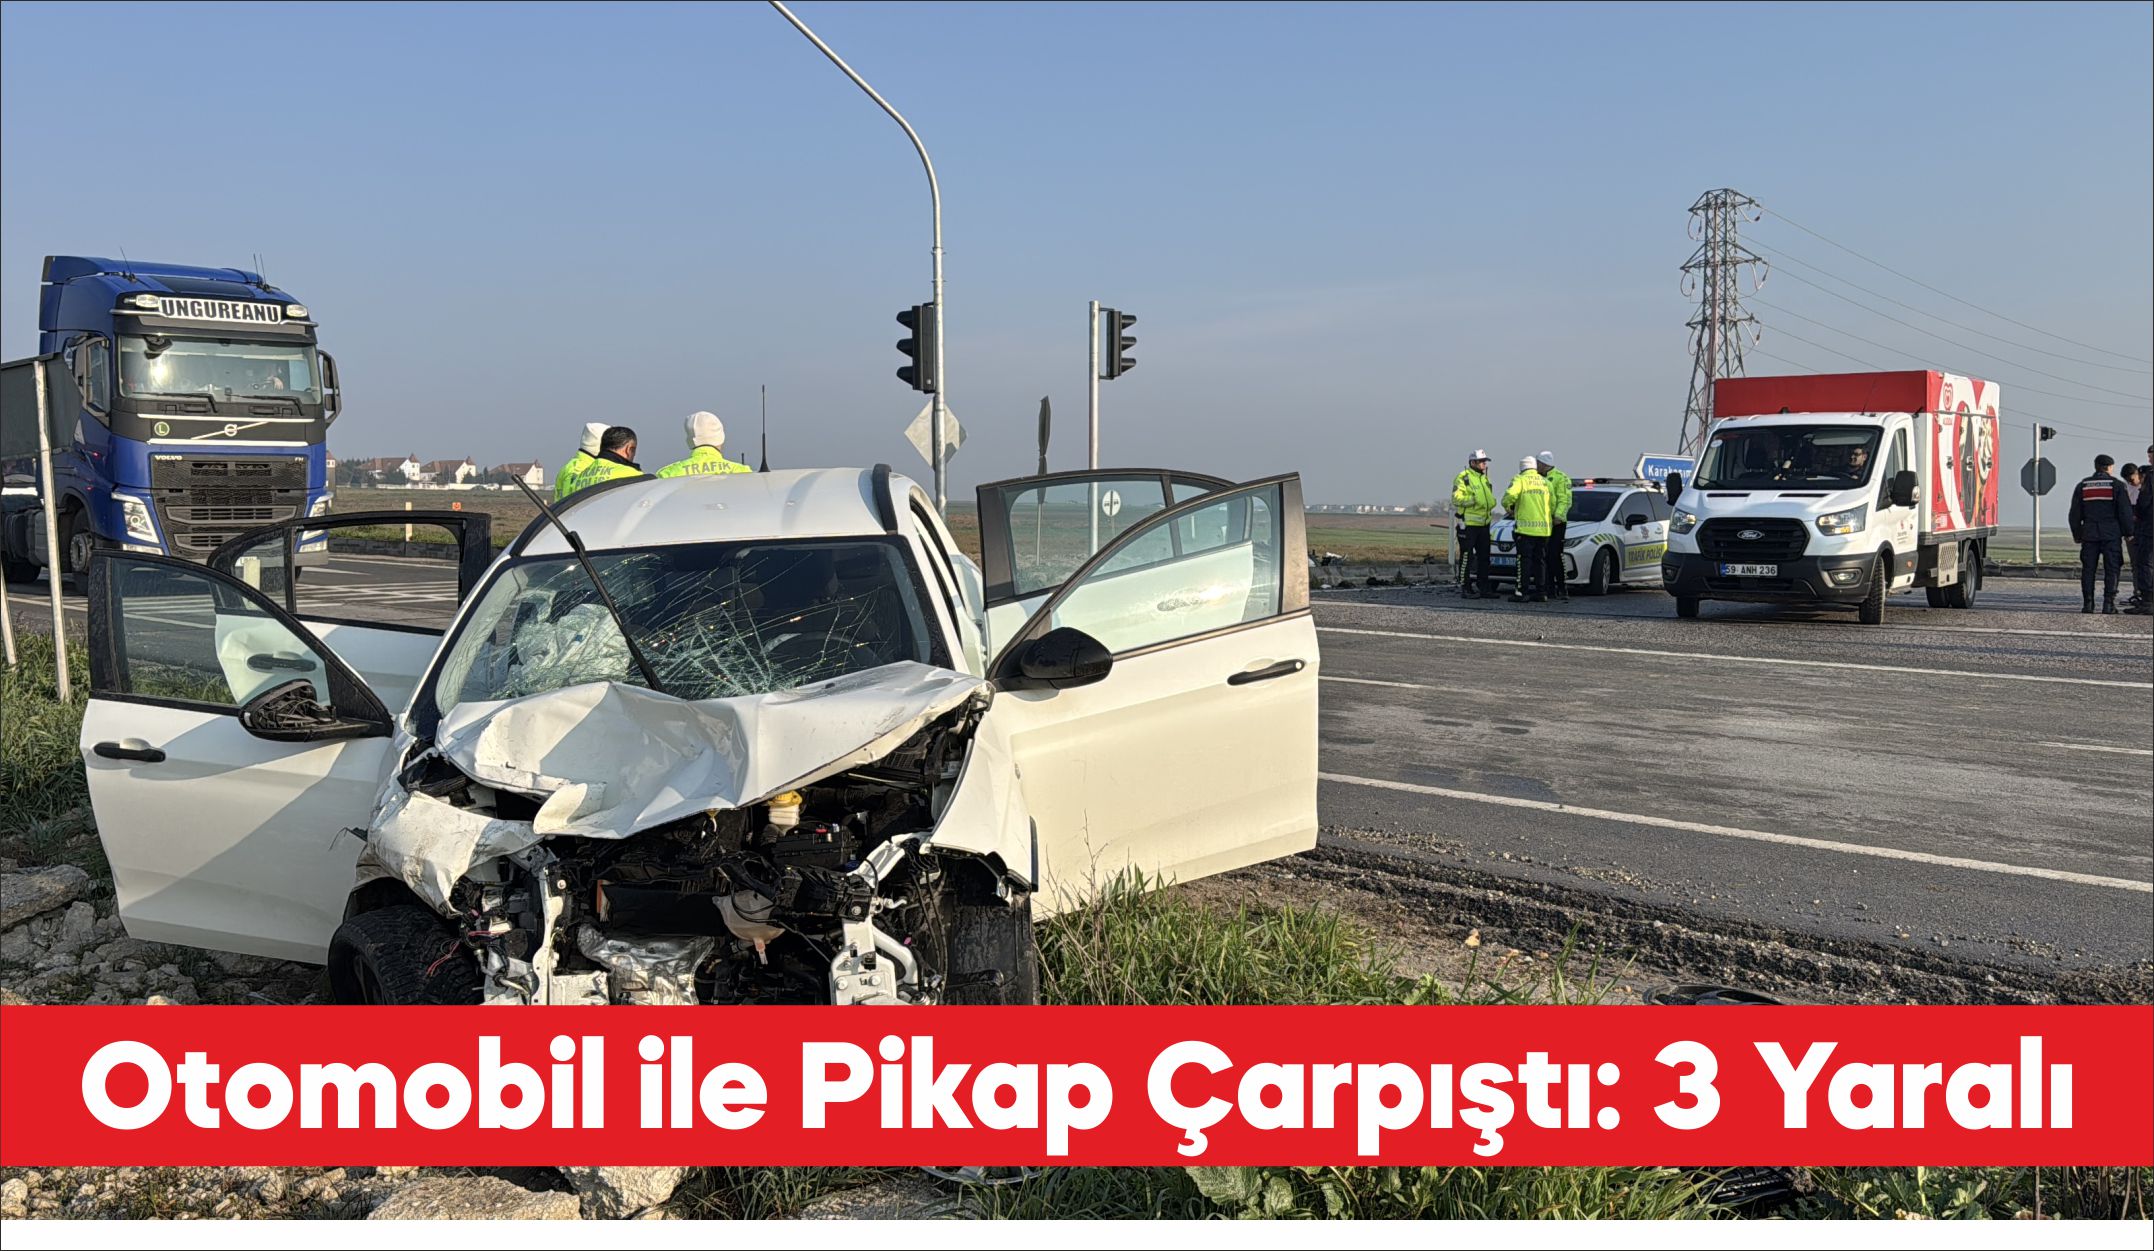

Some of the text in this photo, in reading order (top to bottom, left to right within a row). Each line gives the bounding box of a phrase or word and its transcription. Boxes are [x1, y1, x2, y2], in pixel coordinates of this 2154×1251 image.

[161, 299, 279, 322] UNGUREANU
[1740, 530, 1760, 539] Ford
[1726, 565, 1776, 575] 59 ANH 236
